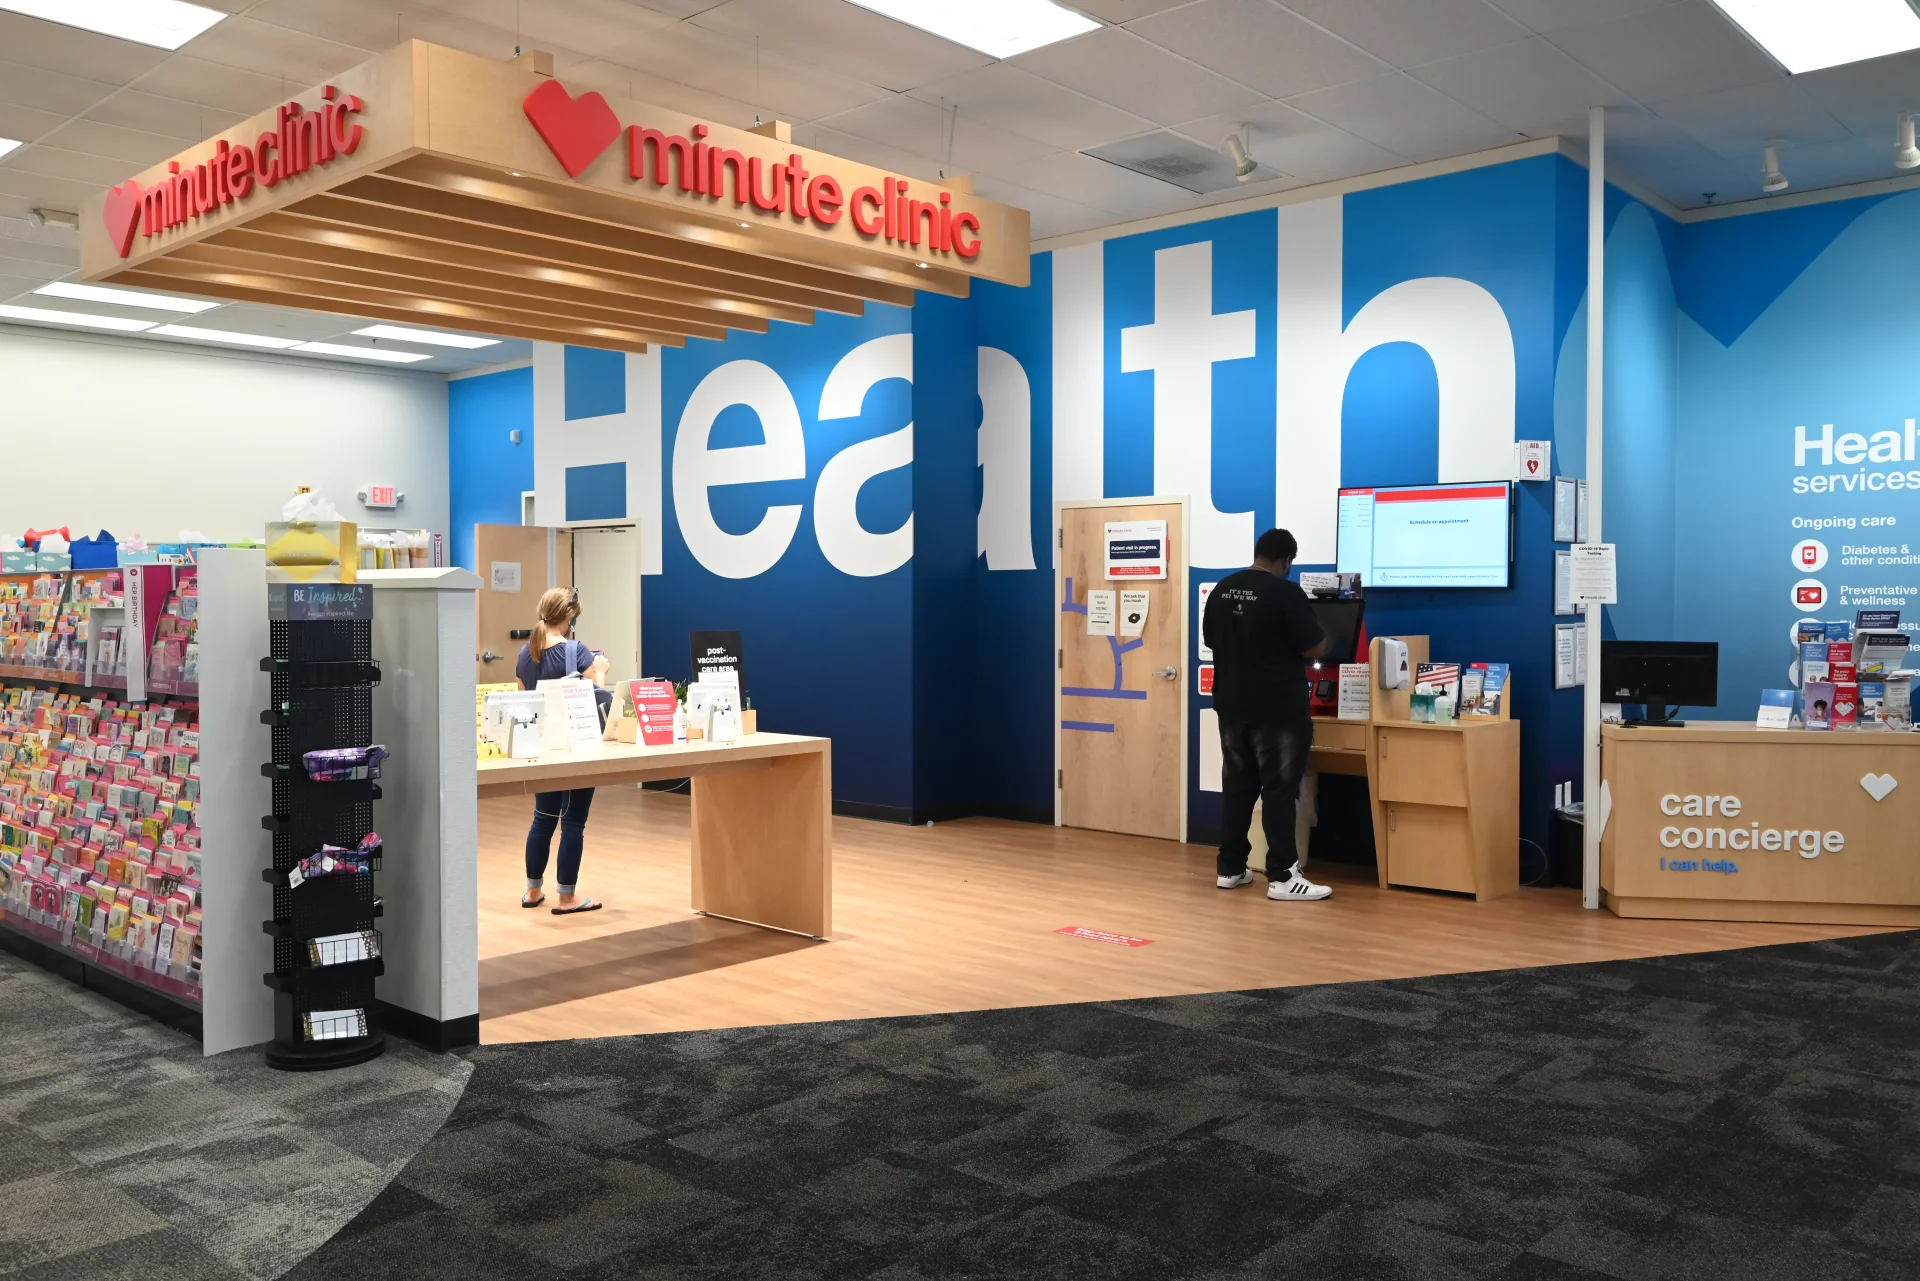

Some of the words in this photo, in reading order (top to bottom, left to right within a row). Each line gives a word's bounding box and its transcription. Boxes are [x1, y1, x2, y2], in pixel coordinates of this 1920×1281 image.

[629, 124, 843, 225] minute
[851, 177, 982, 258] clinic
[533, 196, 1517, 579] Health
[1794, 418, 1920, 467] Heal
[372, 487, 394, 504] EXIT
[1791, 516, 1856, 530] Ongoing
[1861, 516, 1896, 527] care
[1842, 545, 1897, 555] Diabetes
[1901, 544, 1910, 554] &
[1842, 556, 1874, 566] other
[294, 589, 304, 602] BE
[306, 586, 358, 607] Inspired
[1840, 585, 1917, 595] Preventative
[1840, 595, 1848, 605] &
[1852, 596, 1905, 606] wellness
[697, 655, 737, 664] vaccination
[707, 647, 726, 655] post-
[1660, 794, 1741, 817] care
[1659, 822, 1845, 859] concierge
[1660, 857, 1666, 870] I
[1669, 860, 1699, 871] can
[1702, 858, 1739, 875] help.
